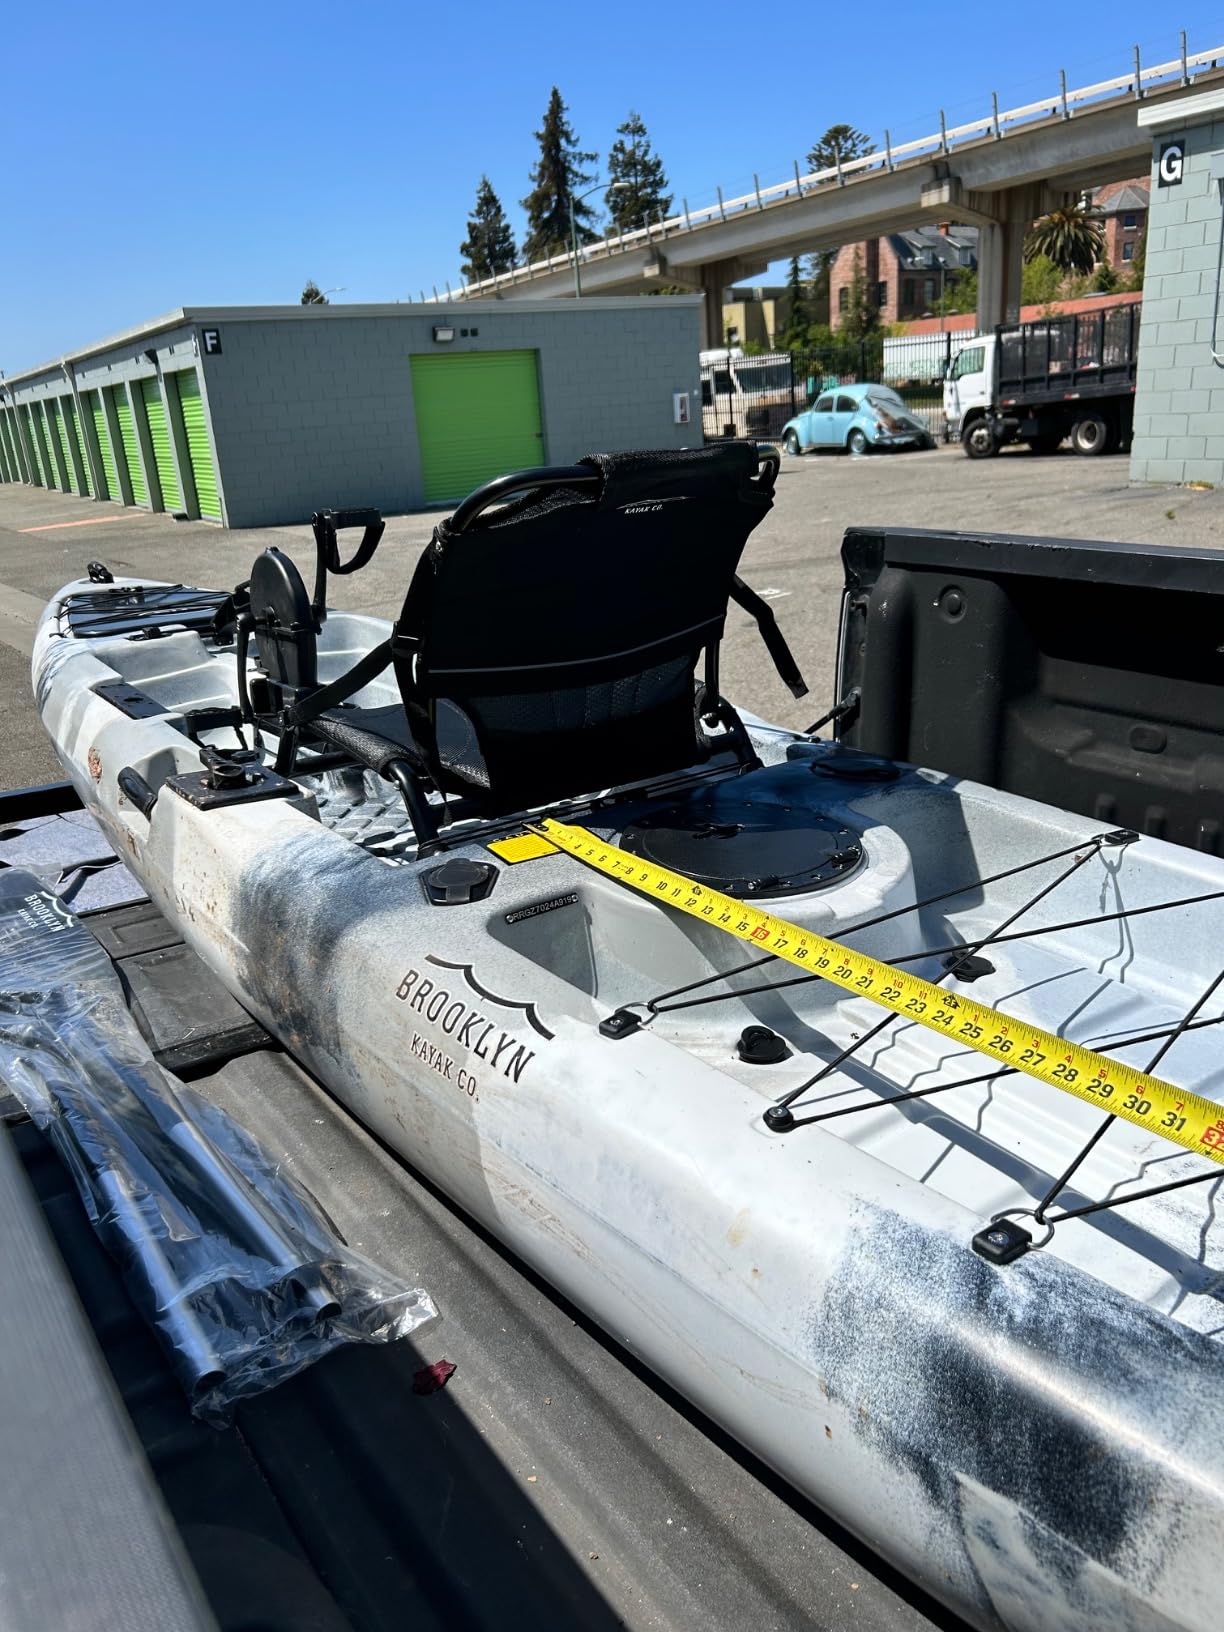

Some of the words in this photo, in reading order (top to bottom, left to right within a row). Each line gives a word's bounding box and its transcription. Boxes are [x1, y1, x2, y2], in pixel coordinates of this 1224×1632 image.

[1161, 146, 1182, 181] G
[205, 332, 217, 352] F
[24, 894, 65, 932] BROOKLYN
[396, 969, 536, 1083] BROOKLYN
[612, 861, 621, 869] 7
[625, 867, 634, 875] 8
[639, 873, 648, 882] 9
[655, 881, 668, 891] 10
[671, 888, 682, 897] 11
[684, 897, 697, 907] 12
[701, 905, 714, 916] 13
[718, 913, 732, 923] 14
[736, 921, 750, 932] 15
[753, 928, 767, 940] 16
[773, 938, 788, 949] 17
[793, 947, 808, 959] 18
[814, 956, 830, 969] 19
[832, 965, 853, 979] 20
[855, 976, 874, 989] 21
[880, 987, 901, 1002] 22
[905, 998, 927, 1013] 23
[932, 1010, 954, 1026] 24
[960, 1022, 983, 1039] 25
[988, 1035, 1013, 1053] 26
[1019, 1049, 1046, 1066] 27
[1052, 1063, 1079, 1082] 28
[1086, 1078, 1114, 1098] 29
[1123, 1094, 1152, 1115] 30
[1161, 1111, 1187, 1132] 31
[411, 1033, 454, 1080] KAYAK
[457, 1069, 480, 1101] CO.
[893, 979, 903, 989] 10
[919, 990, 928, 1000] 11
[1001, 1026, 1008, 1035] 2
[1032, 1039, 1039, 1048] 3
[1065, 1055, 1072, 1063] 4
[1098, 1069, 1107, 1079] 5
[1136, 1085, 1144, 1094] 6
[1175, 1101, 1184, 1111] 7
[1216, 1119, 1224, 1130] 8
